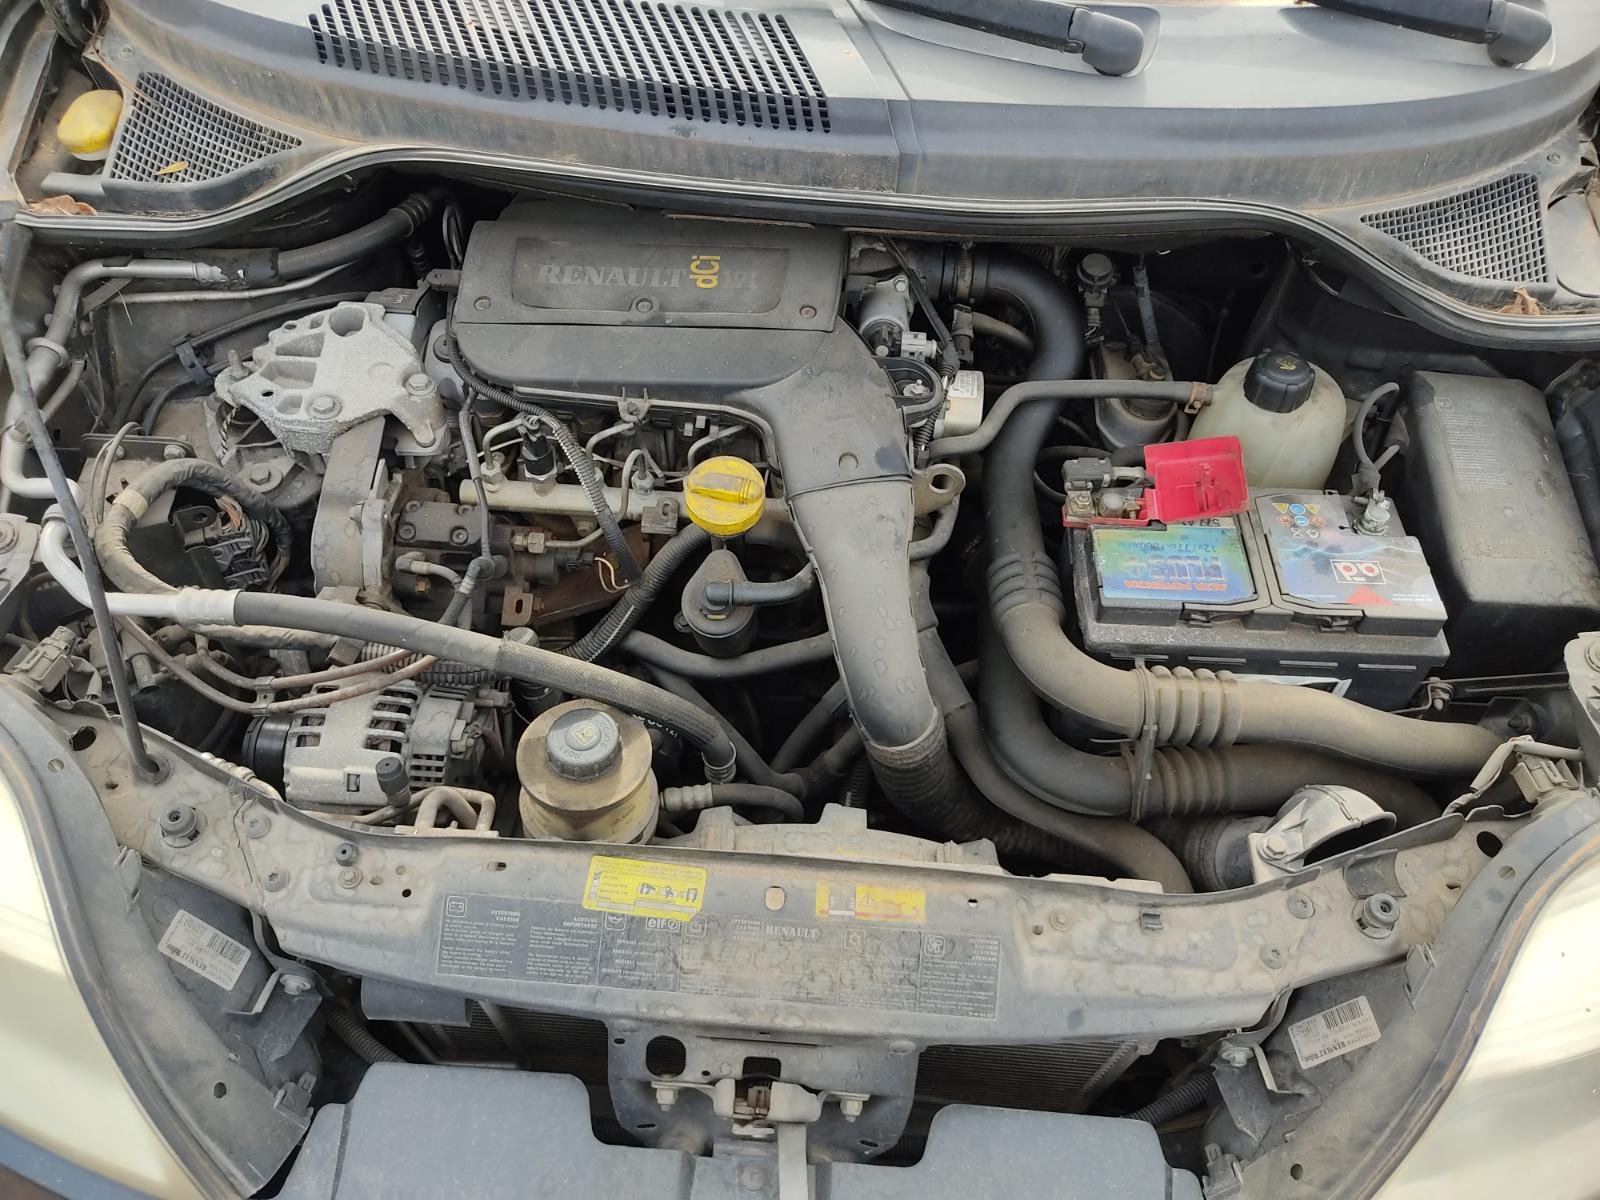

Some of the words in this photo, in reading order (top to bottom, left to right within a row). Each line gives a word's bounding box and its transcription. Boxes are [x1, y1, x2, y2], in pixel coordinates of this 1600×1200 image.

[534, 263, 686, 288] RENAULT
[689, 255, 720, 289] dCi
[766, 926, 817, 938] RENAULT
